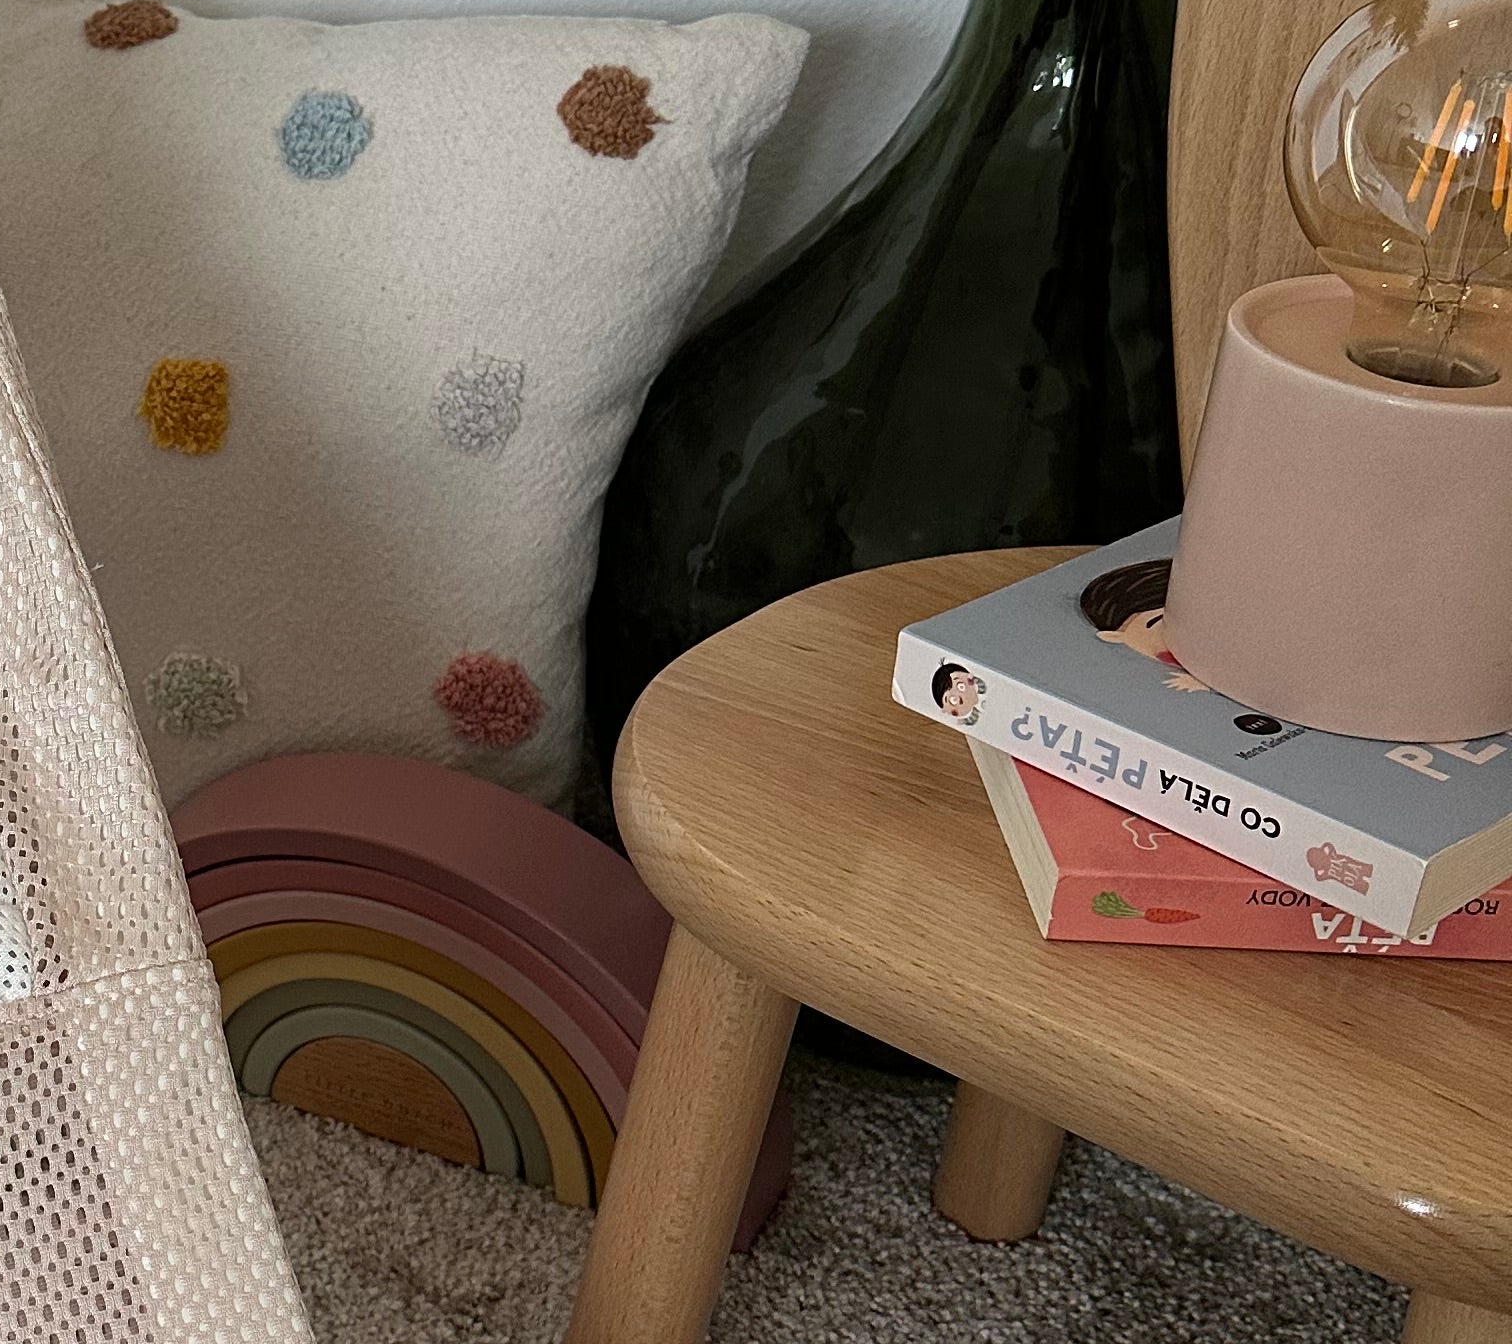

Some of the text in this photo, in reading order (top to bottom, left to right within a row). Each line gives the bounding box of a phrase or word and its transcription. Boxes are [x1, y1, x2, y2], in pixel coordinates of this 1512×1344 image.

[1010, 706, 1281, 839] CO DĚLÁ PÉŤA?
[1245, 889, 1311, 907] VODY
